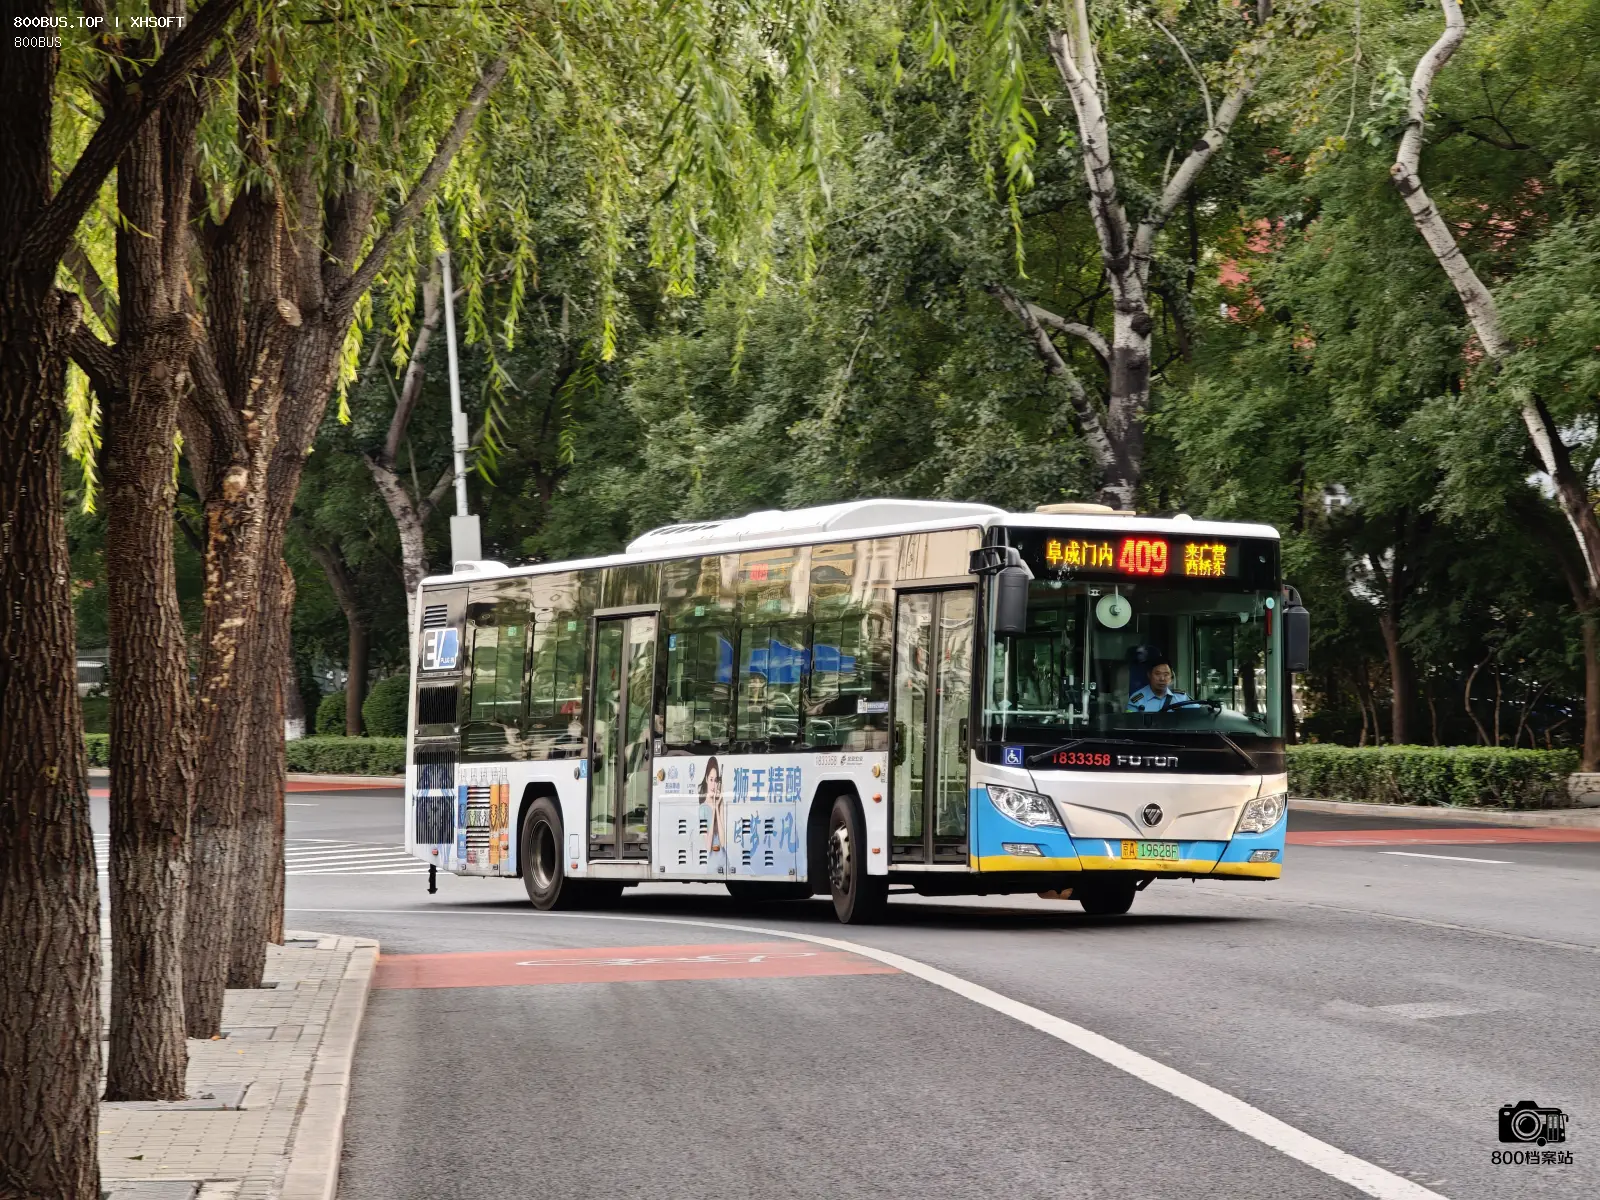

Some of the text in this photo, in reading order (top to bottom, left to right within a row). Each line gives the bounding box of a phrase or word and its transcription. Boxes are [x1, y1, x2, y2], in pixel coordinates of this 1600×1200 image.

[1046, 539, 1114, 568] 阜成门内
[1119, 539, 1168, 574] 409
[1184, 543, 1227, 561] 来广营
[1184, 560, 1227, 577] 西桥东
[1052, 751, 1111, 766] 1833358
[732, 765, 802, 804] 狮王精酿
